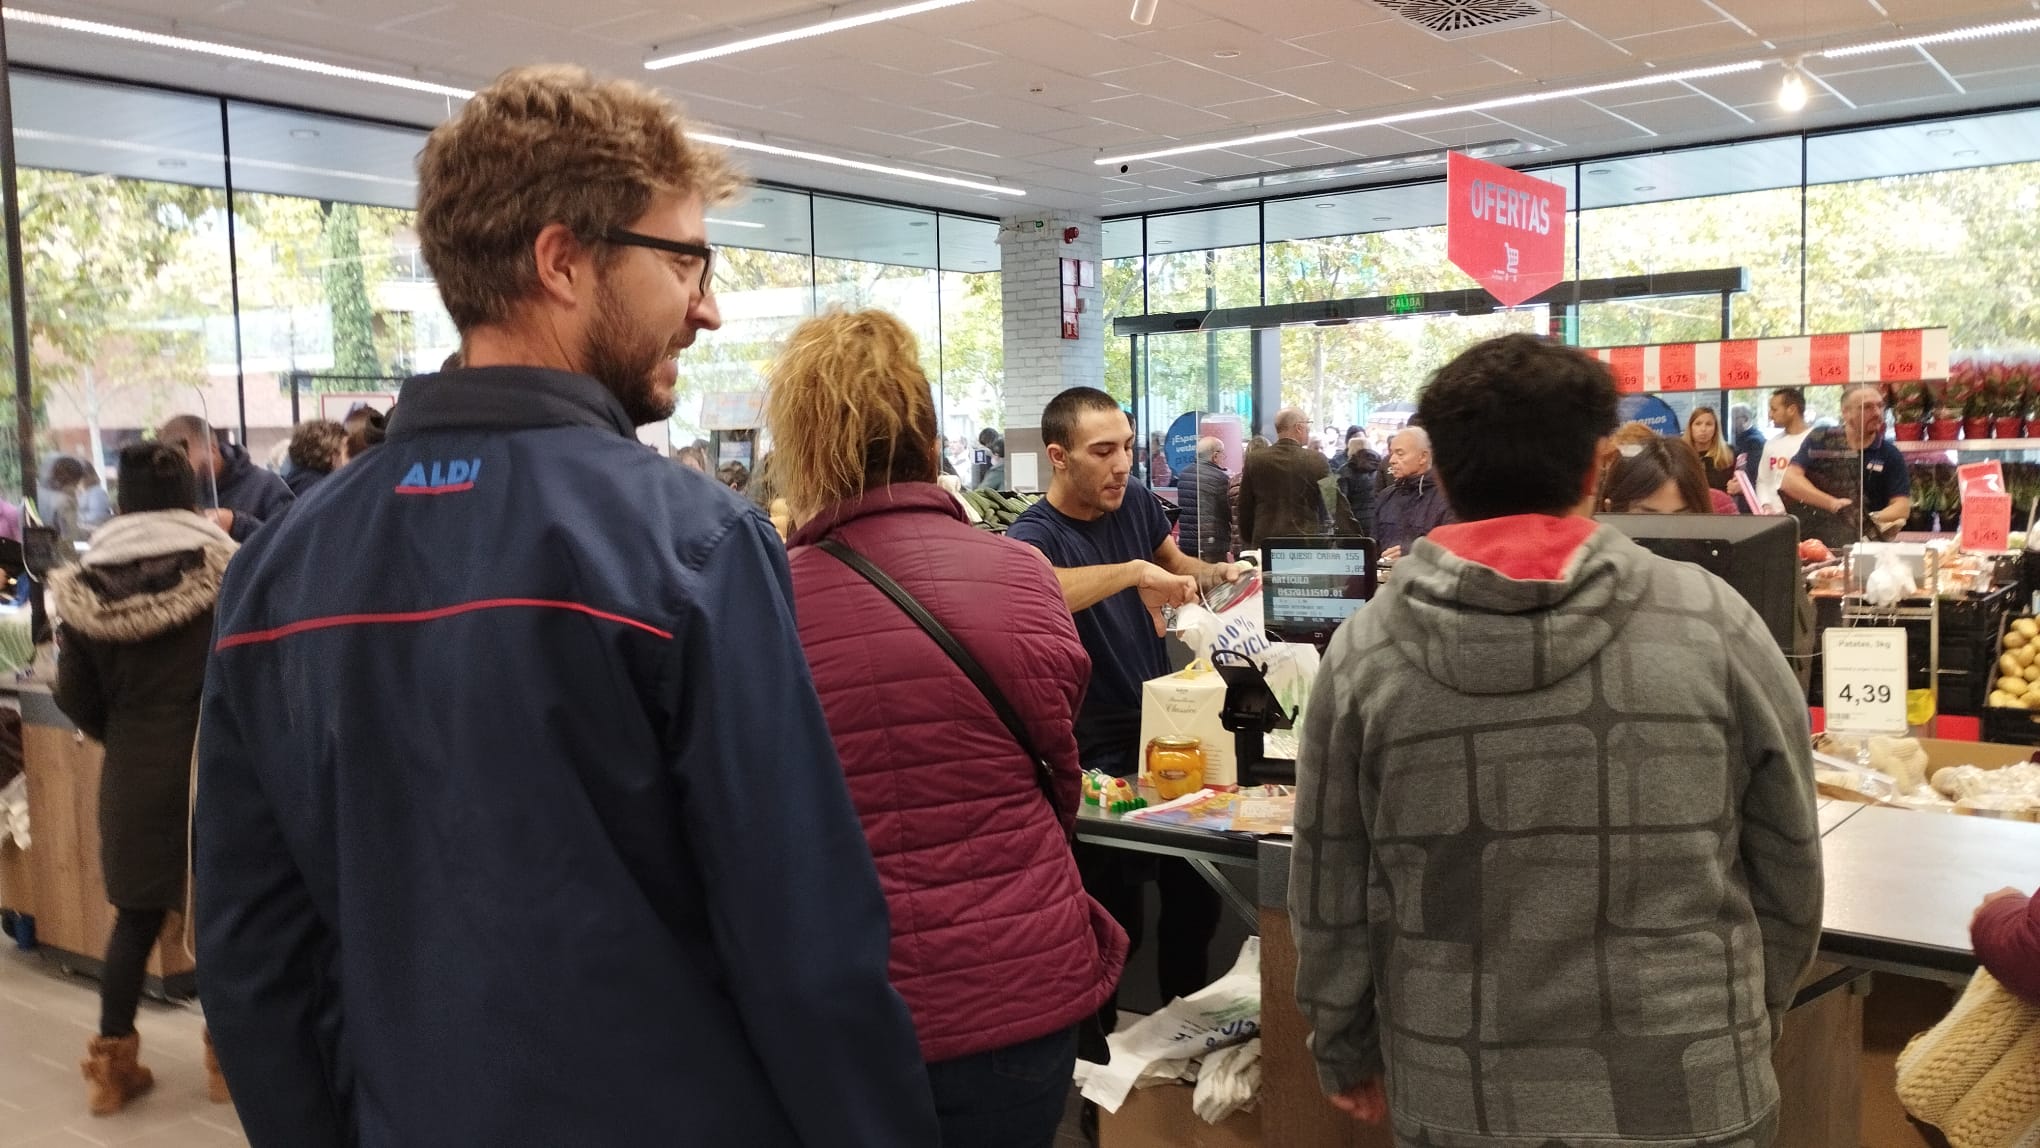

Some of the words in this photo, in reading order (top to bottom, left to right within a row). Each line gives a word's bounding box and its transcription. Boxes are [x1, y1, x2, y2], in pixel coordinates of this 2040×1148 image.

[1470, 178, 1550, 236] OFERTAS
[1390, 296, 1421, 309] SALIDA
[400, 457, 482, 489] ALDI
[1271, 551, 1285, 561] ECO
[1838, 683, 1892, 706] 4,39
